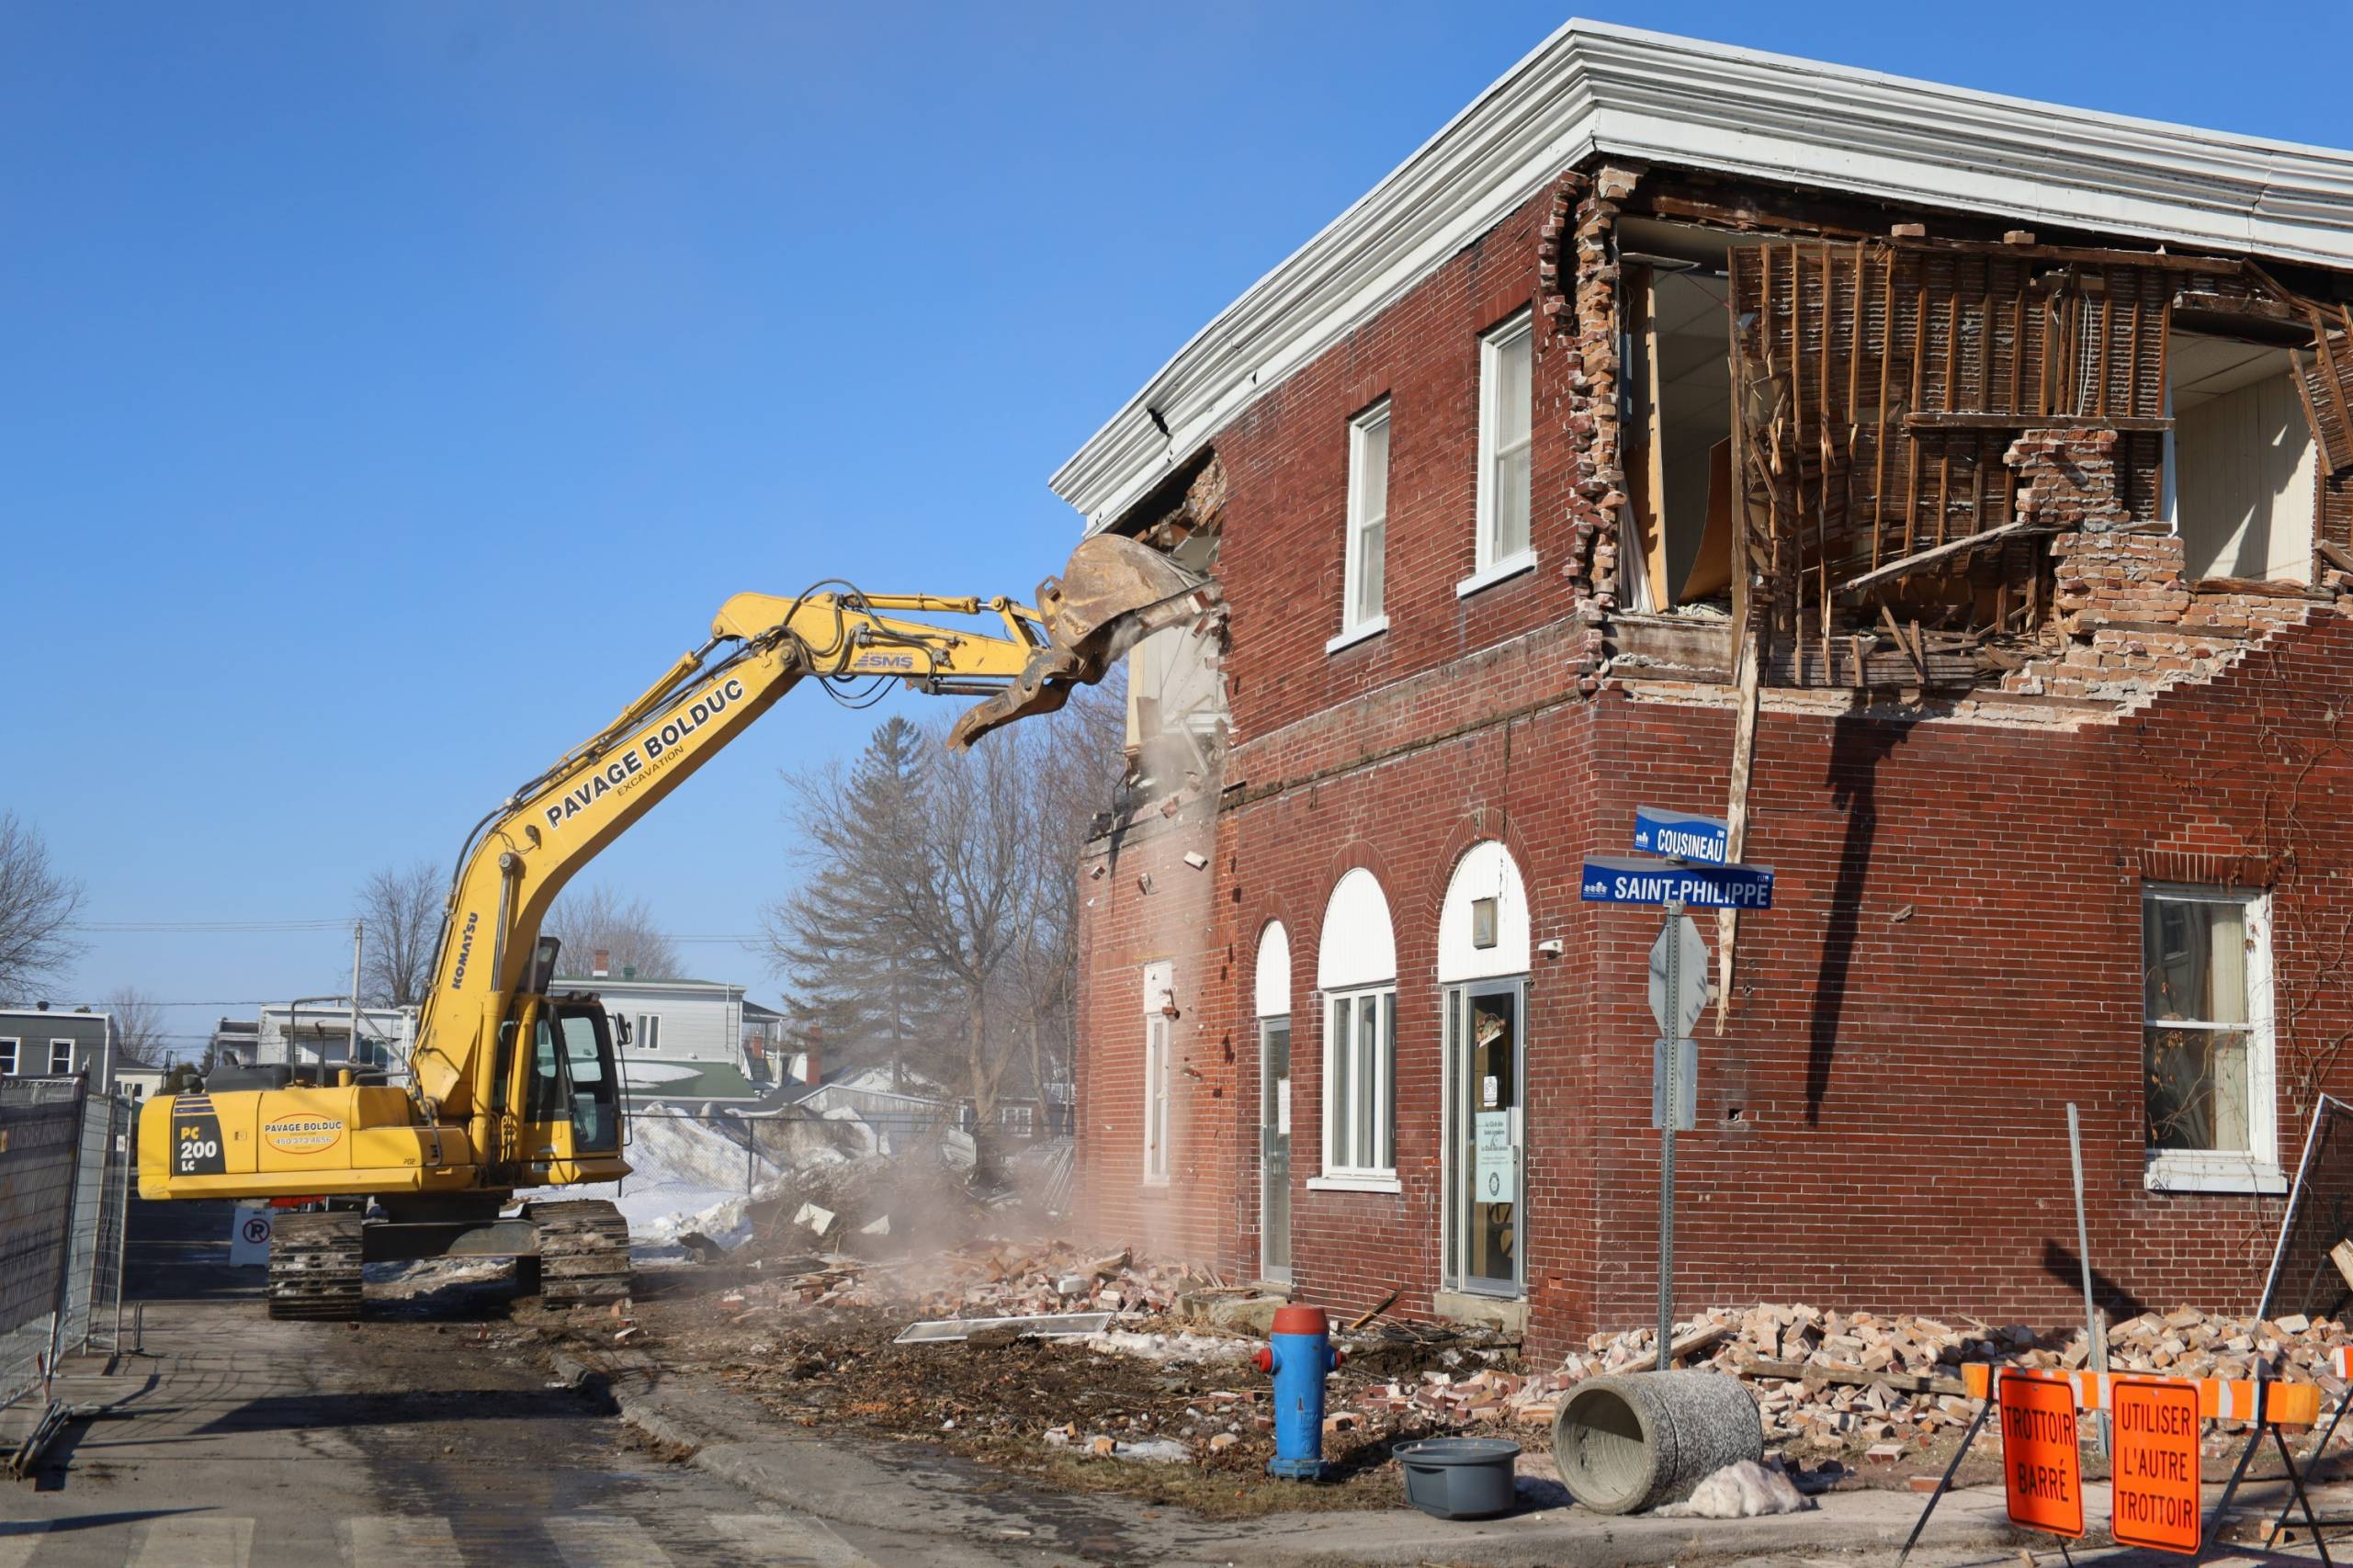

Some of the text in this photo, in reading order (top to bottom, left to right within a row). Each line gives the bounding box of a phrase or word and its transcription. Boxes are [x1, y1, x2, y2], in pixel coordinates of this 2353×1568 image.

[869, 656, 913, 668] SMS
[547, 680, 743, 829] PAVAGE BOLDUC
[617, 745, 684, 796] EXCAVATION
[1657, 829, 1724, 863] COUSINEAU
[1614, 876, 1768, 906] SAINT-PHILIPPE
[451, 911, 479, 990] KOMATSU
[181, 1126, 199, 1140] PC
[265, 1122, 342, 1132] PAVAGE BOLDUC
[181, 1141, 217, 1159] 200
[181, 1160, 195, 1171] LC
[2004, 1405, 2073, 1447] TROTTOIR
[2121, 1402, 2190, 1437] UTILISER
[2018, 1459, 2069, 1503] BARRÉ
[2124, 1447, 2189, 1483] L'AUTRE
[2119, 1490, 2193, 1529] TROTTOIR
